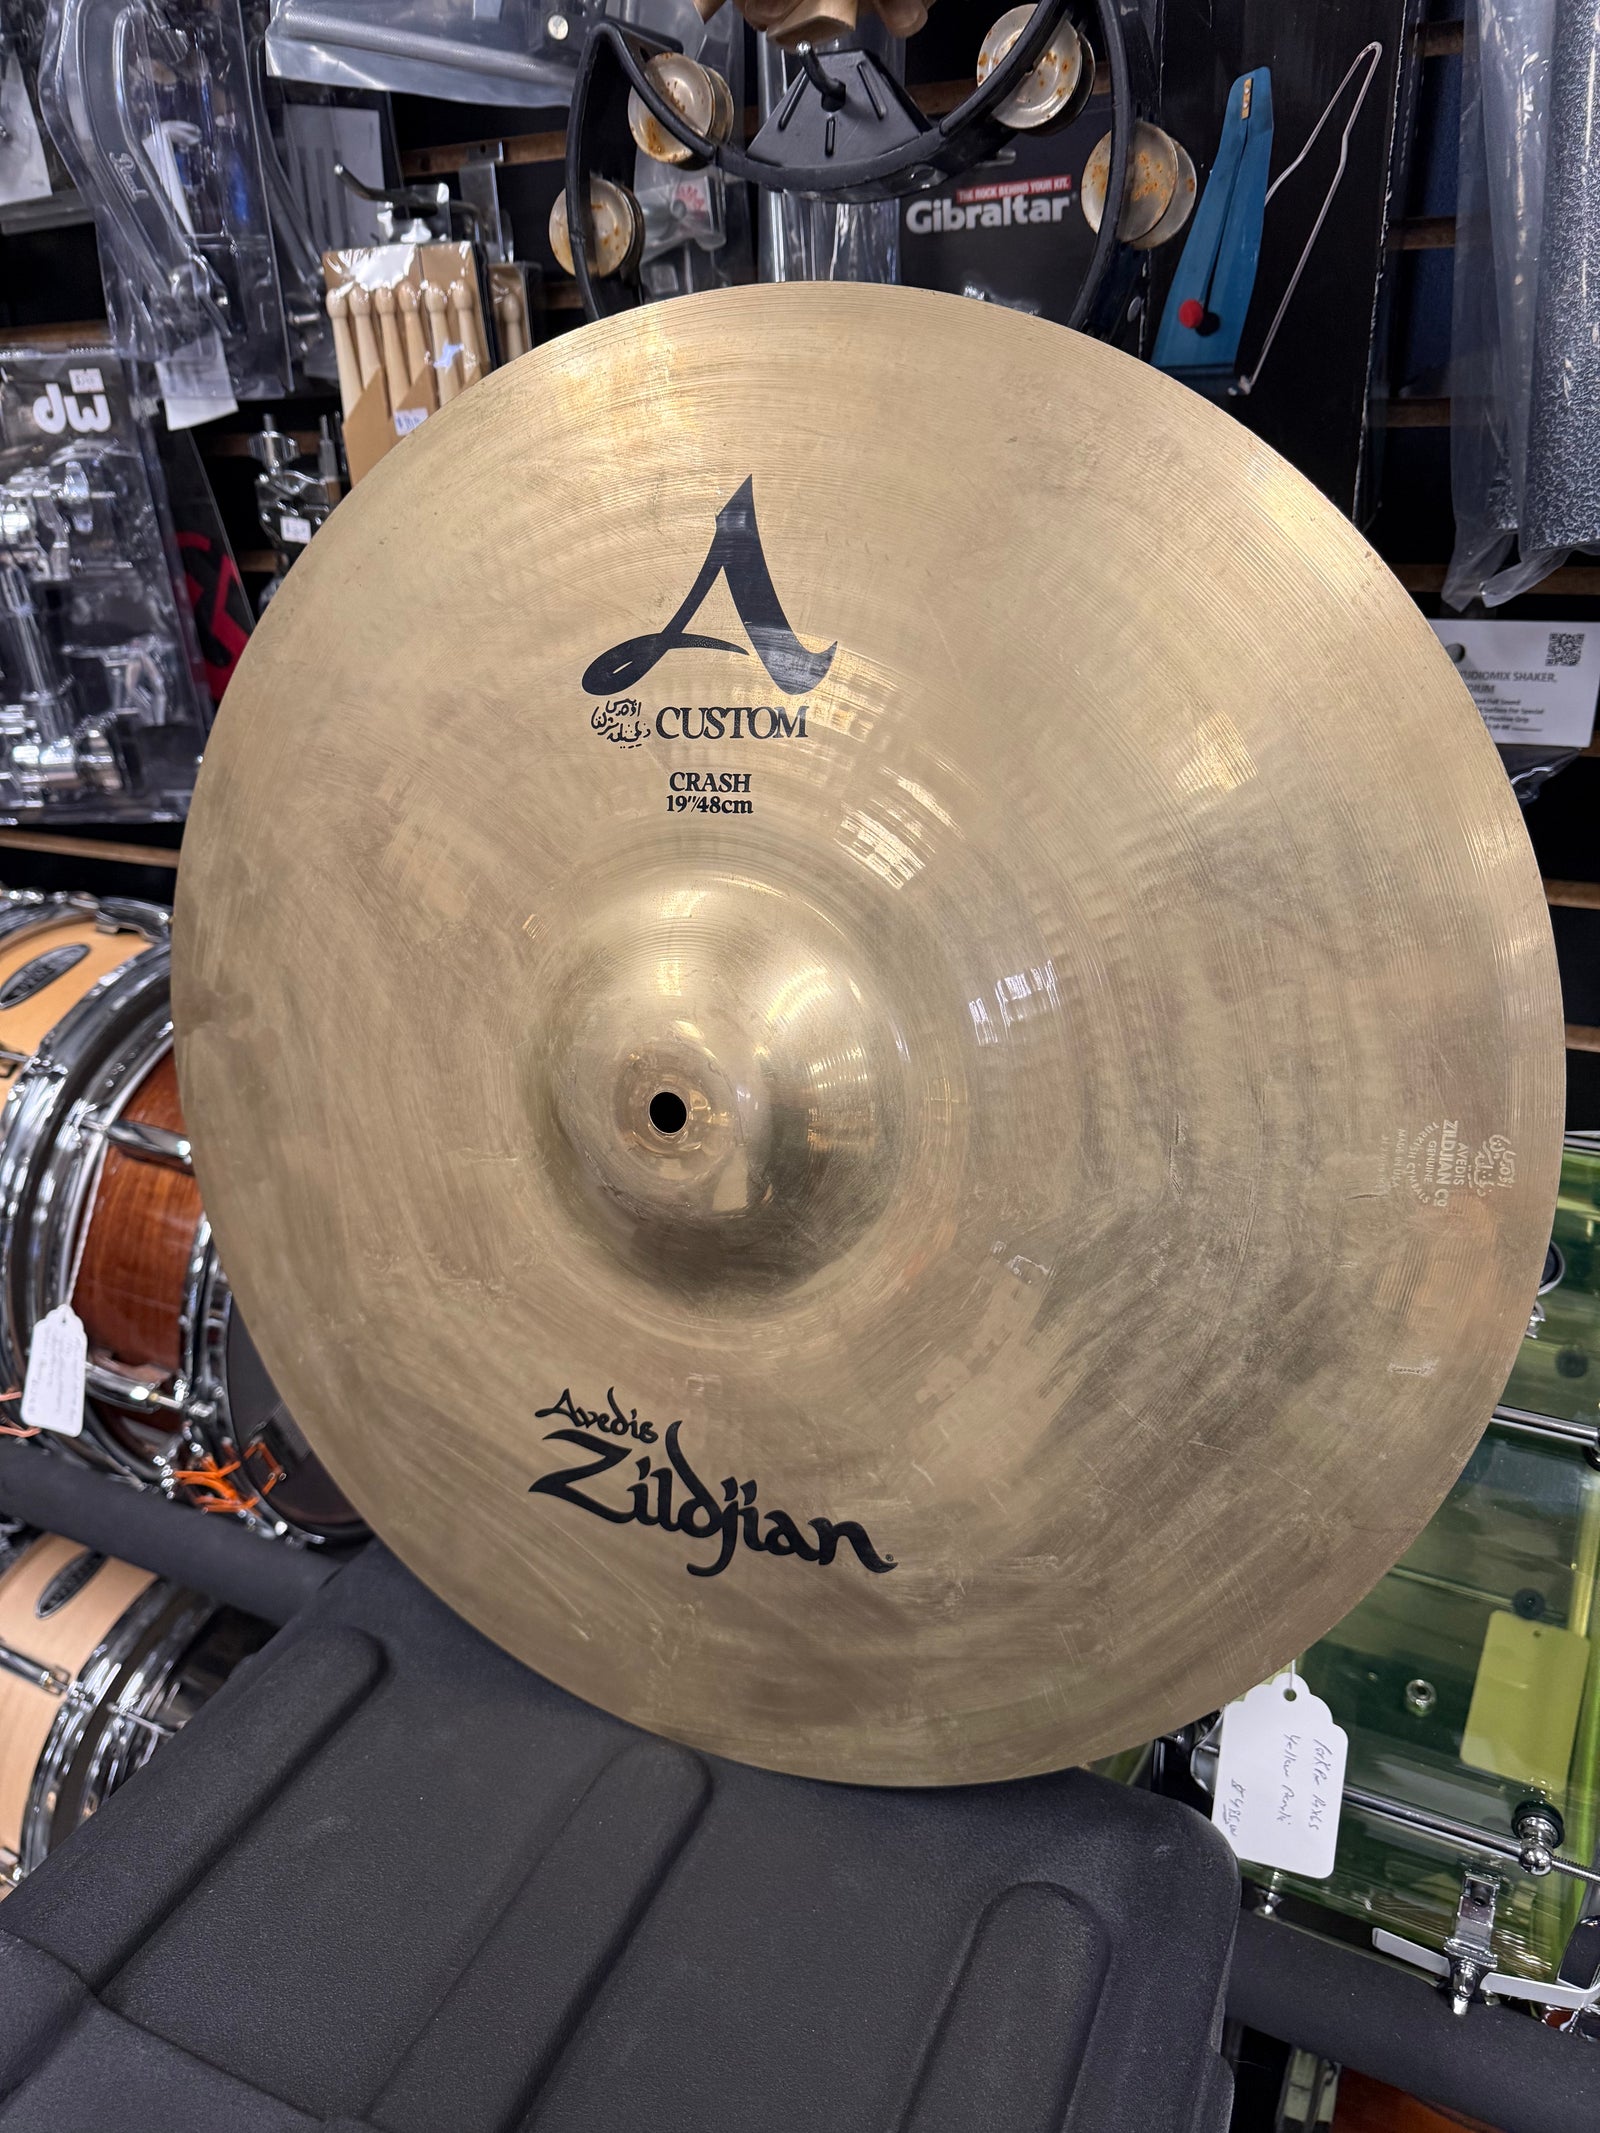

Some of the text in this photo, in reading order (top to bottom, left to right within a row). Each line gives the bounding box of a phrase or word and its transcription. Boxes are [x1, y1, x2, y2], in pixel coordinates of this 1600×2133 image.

[109, 152, 149, 202] Pearl
[975, 186, 998, 200] ROCK
[1030, 179, 1051, 193] YOUR
[906, 194, 1070, 234] Gibraltar
[33, 383, 111, 434] dw
[582, 473, 838, 696] A
[1460, 670, 1511, 681] TUDIOMIX
[1468, 684, 1495, 694] DIUM
[656, 705, 810, 740] CUSTOM
[669, 771, 752, 793] CRASH
[1406, 1121, 1440, 1204] TURKISH CYMBALS
[1424, 1140, 1438, 1183] GENUINE
[1437, 1119, 1459, 1185] ZILDJIAN
[1453, 1142, 1469, 1186] AVEDIS
[535, 1386, 659, 1444] Avedis
[528, 1420, 899, 1577] Zildjian
